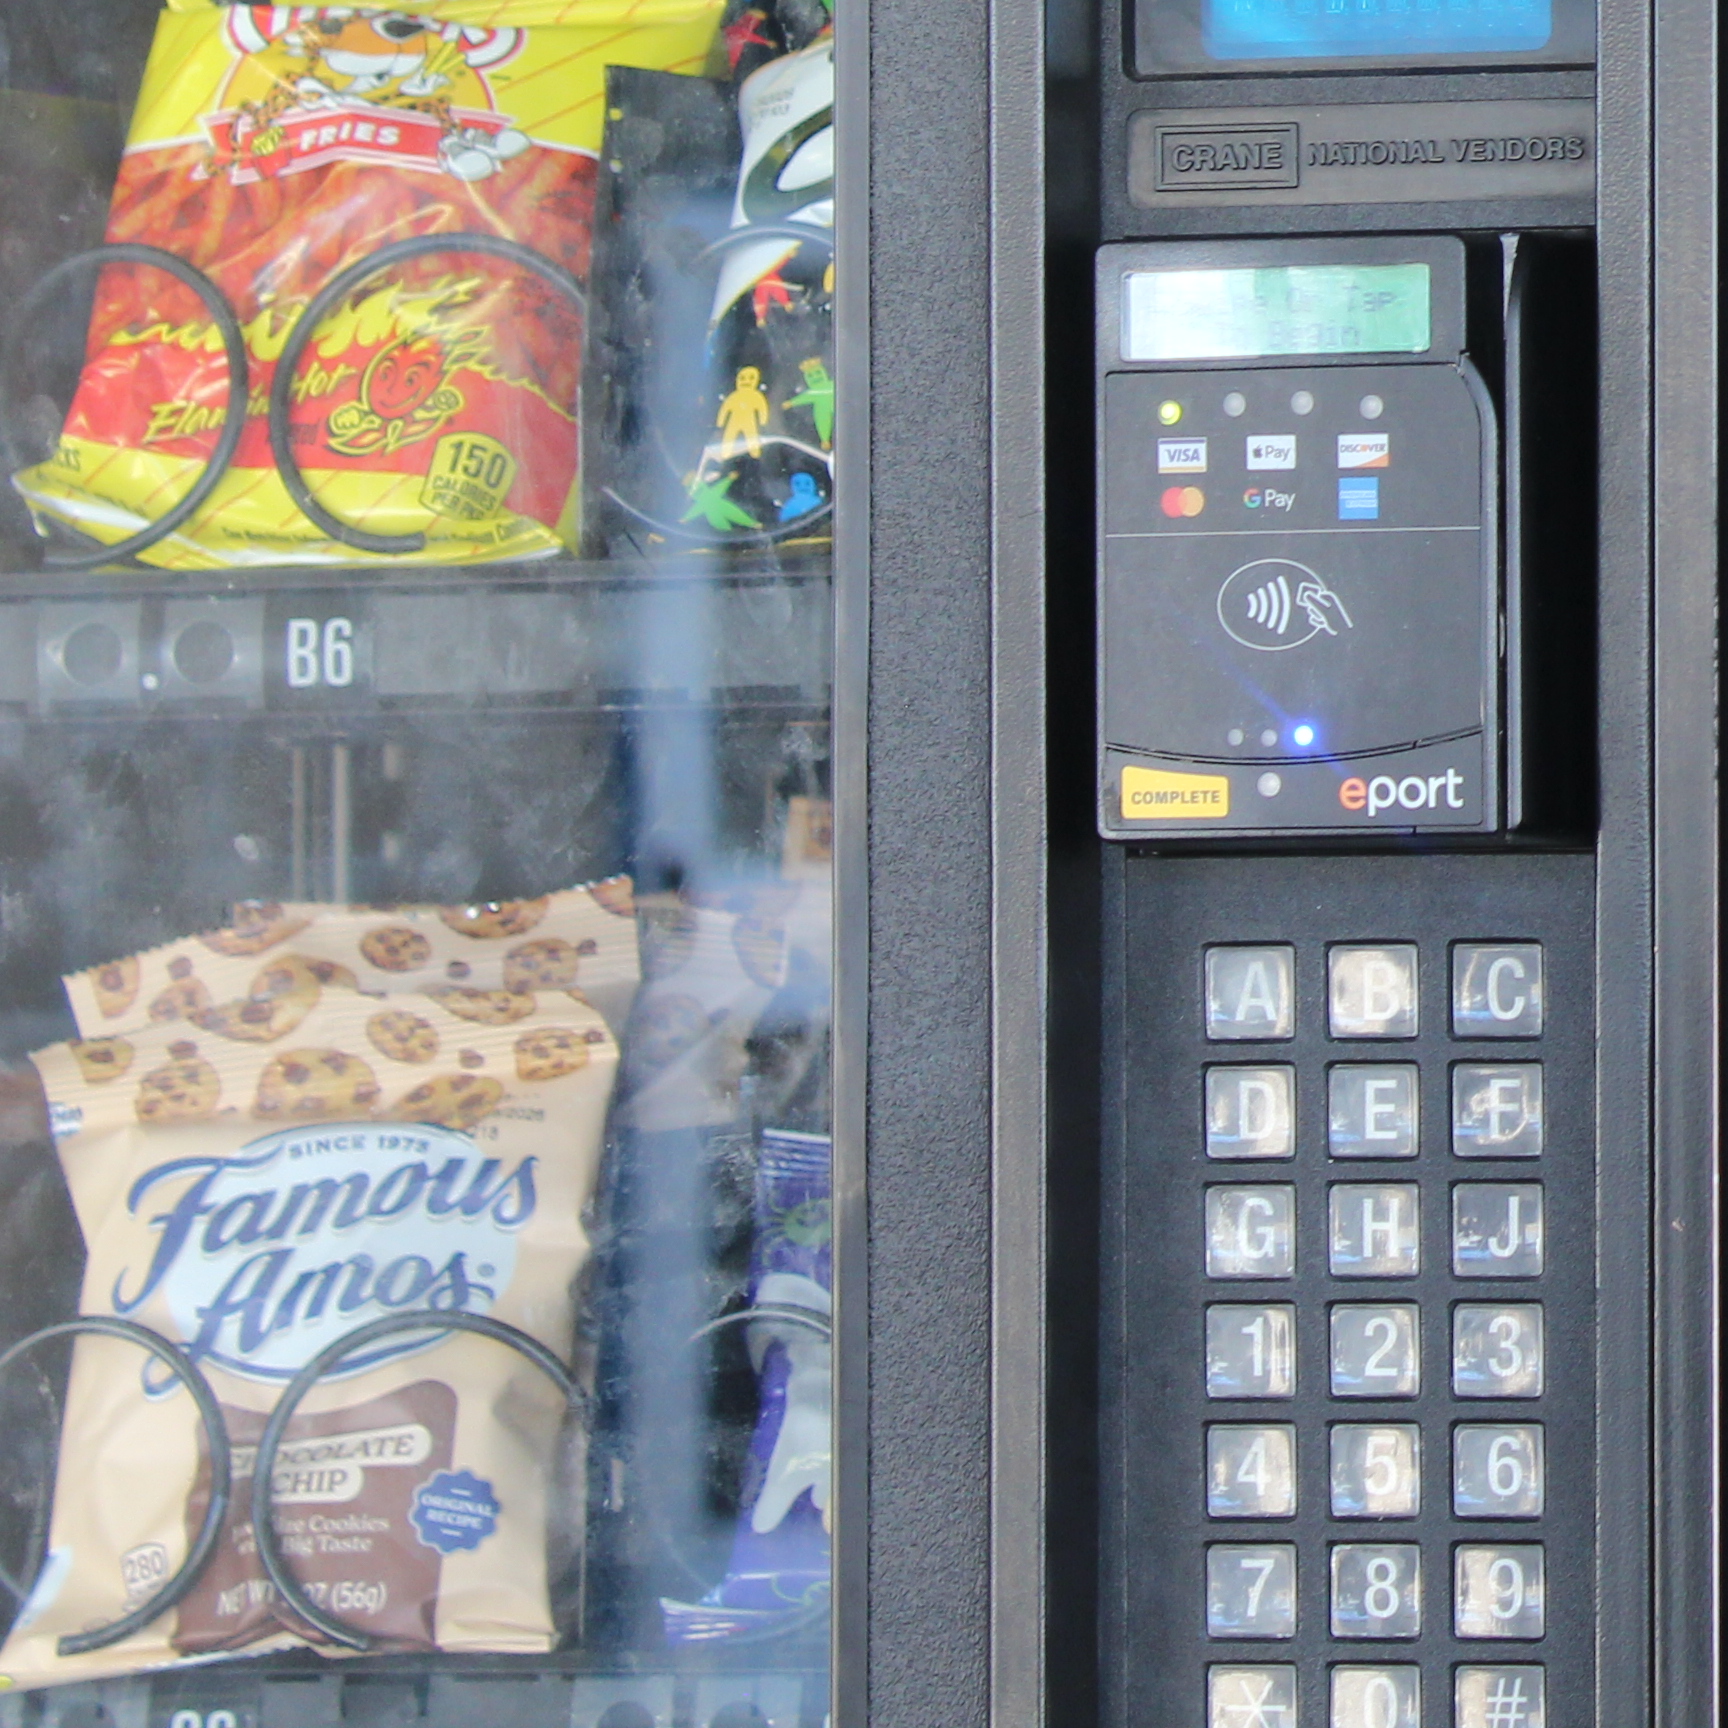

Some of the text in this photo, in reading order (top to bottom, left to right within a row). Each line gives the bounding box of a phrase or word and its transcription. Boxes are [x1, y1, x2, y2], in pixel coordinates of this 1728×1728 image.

[299, 121, 401, 151] FRIES
[1171, 135, 1587, 173] CRANE NATIONAL VENDORS
[448, 440, 508, 489] 150
[1165, 443, 1387, 463] VISA Pay DISCOVER
[431, 475, 498, 512] CALORIES
[1264, 488, 1296, 511] Pay
[286, 616, 353, 688] B6
[1131, 789, 1221, 806] COMPLETE
[1338, 768, 1465, 817] eport
[1234, 957, 1525, 1021] A B C
[1238, 1078, 1522, 1140] D E F
[287, 1134, 366, 1159] SINCE
[112, 1155, 541, 1315] Famous
[1236, 1196, 1521, 1260] G H J
[141, 1247, 497, 1399] Amos
[1241, 1315, 1523, 1378] 1 2 3
[273, 1469, 349, 1494] CHIP
[1236, 1435, 1523, 1496] 4 5 6
[308, 1513, 390, 1533] Cookies
[421, 1493, 495, 1517] ORIGINAL
[425, 1508, 483, 1529] RECIPE
[318, 1534, 373, 1553] Taste
[122, 1550, 163, 1583] 280
[331, 1581, 387, 1615] (56g)
[1239, 1557, 1524, 1619] 7 8 9
[1364, 1677, 1399, 1728] 0
